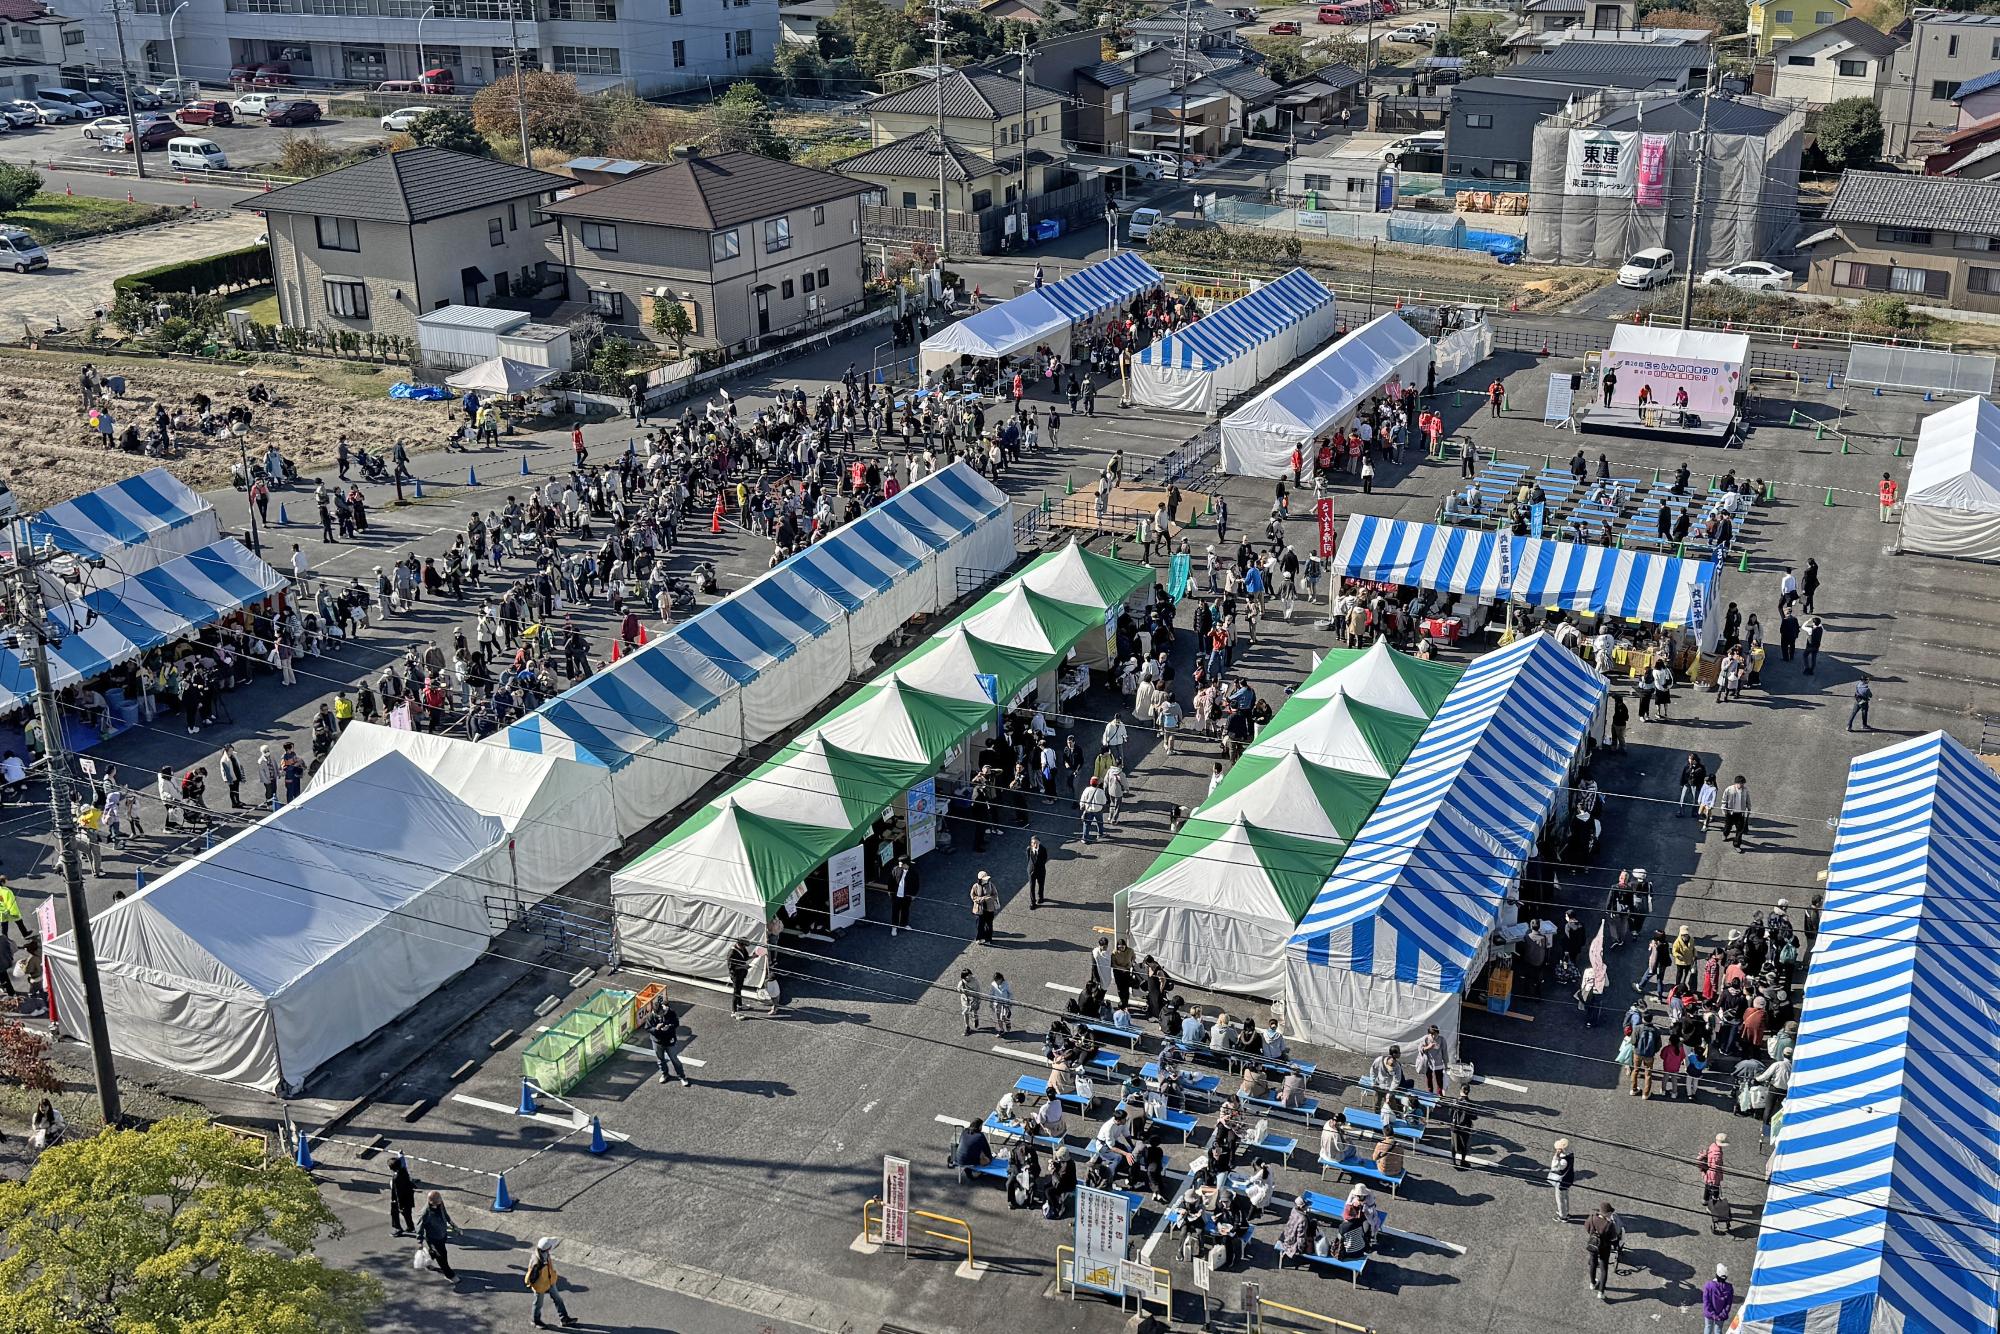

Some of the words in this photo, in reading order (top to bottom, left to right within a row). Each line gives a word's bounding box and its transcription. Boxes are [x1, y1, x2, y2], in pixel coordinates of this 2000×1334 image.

[1583, 146, 1619, 164] 東建
[1572, 179, 1625, 190] 東建コーポレーション
